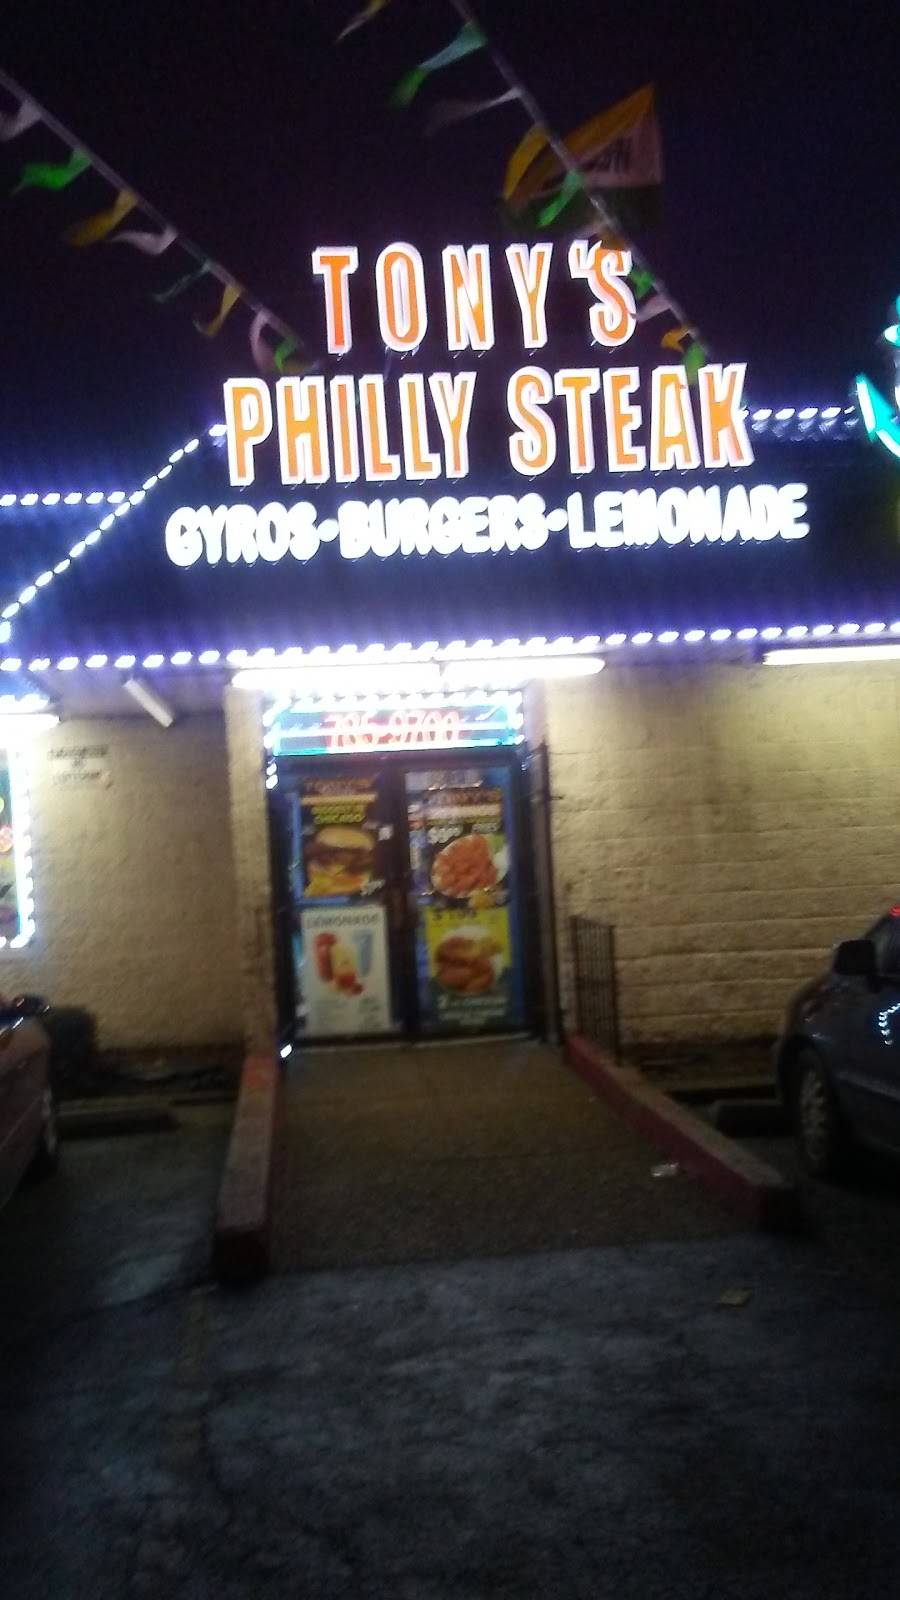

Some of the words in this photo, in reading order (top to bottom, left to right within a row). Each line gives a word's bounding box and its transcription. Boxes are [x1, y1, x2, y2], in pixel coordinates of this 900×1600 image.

[312, 240, 637, 355] TONY'S
[223, 371, 477, 487] PHILLY
[506, 362, 756, 477] STEAK
